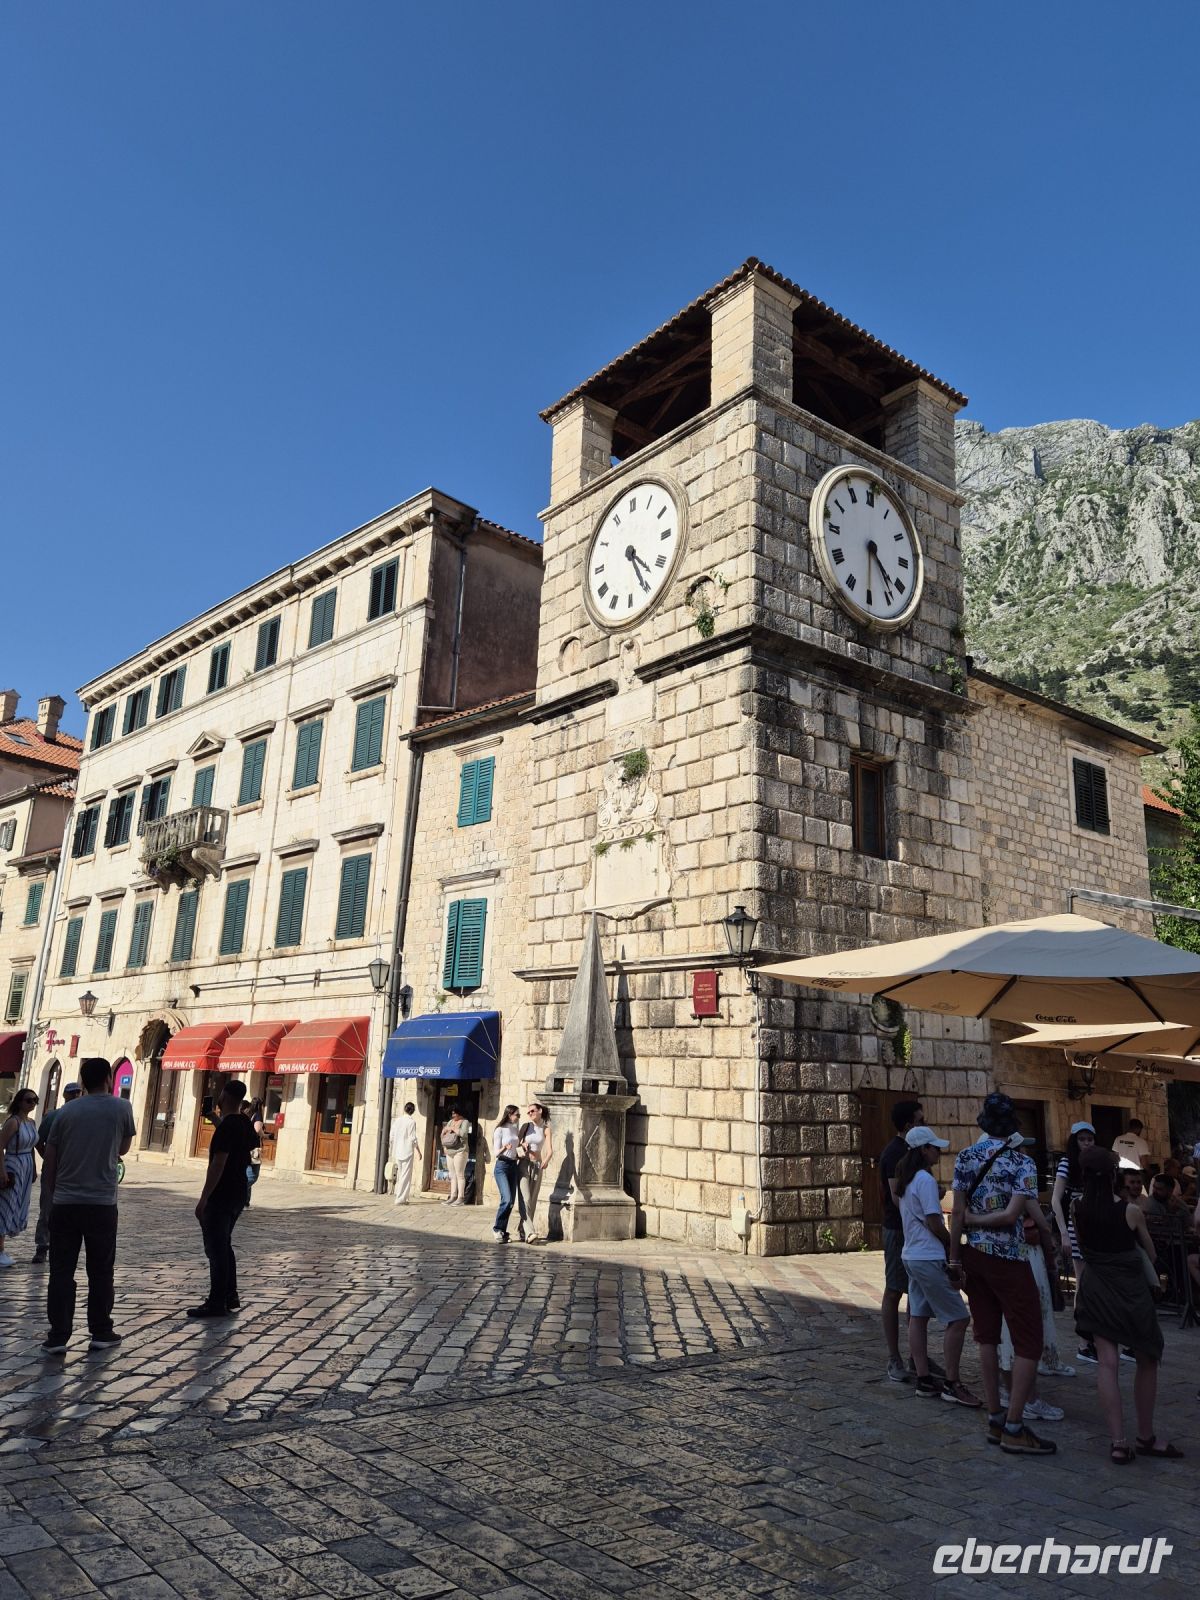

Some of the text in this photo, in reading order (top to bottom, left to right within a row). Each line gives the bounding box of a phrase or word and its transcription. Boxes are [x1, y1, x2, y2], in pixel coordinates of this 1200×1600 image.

[646, 495, 653, 510] I
[884, 509, 890, 520] I
[894, 533, 904, 542] II
[898, 557, 909, 569] III
[278, 1063, 290, 1072] PRVA
[291, 1063, 309, 1072] BANKA
[396, 1066, 418, 1075] TOBACCO
[424, 1067, 440, 1076] PRESS
